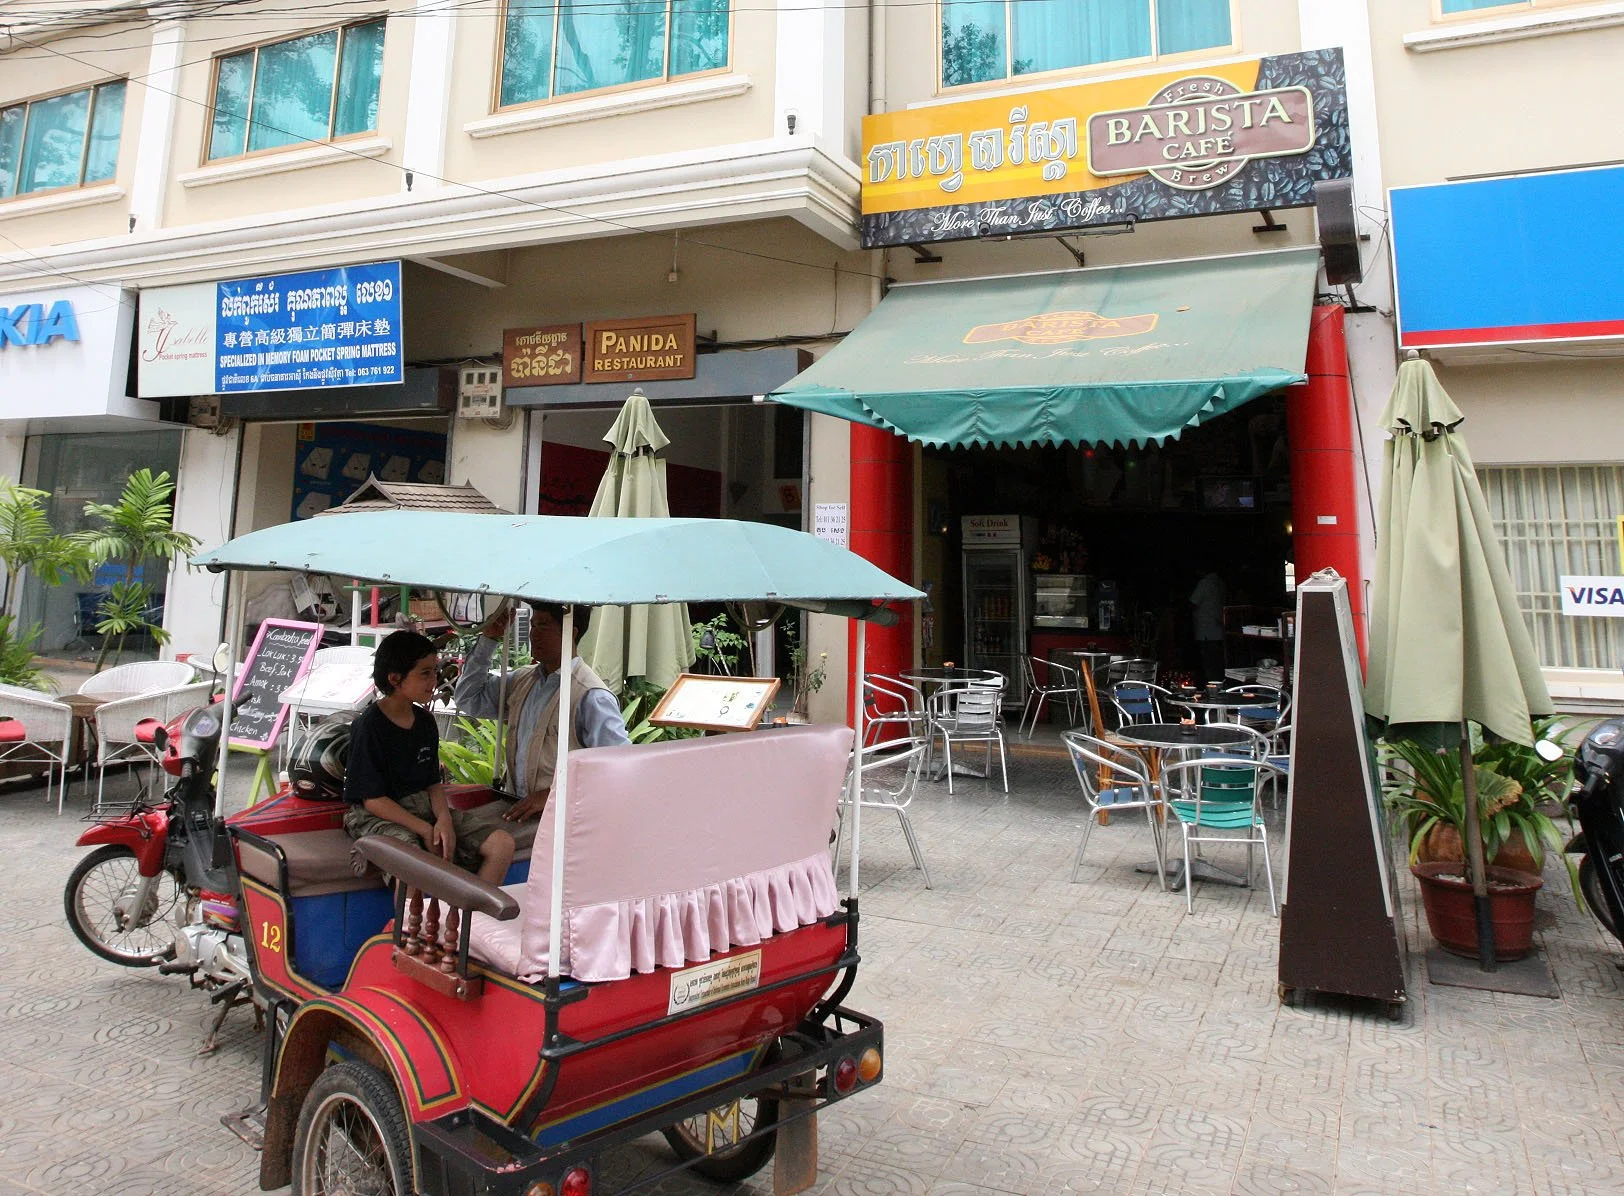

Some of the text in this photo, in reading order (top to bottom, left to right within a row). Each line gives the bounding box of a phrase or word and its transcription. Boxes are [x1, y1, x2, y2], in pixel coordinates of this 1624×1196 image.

[1163, 81, 1225, 103] Fresh
[1106, 97, 1293, 146] BARISTA
[1162, 131, 1235, 160] CAFÉ
[1171, 163, 1230, 184] Brew
[931, 212, 975, 232] More
[978, 207, 1022, 226] Than
[1019, 199, 1058, 226] Just
[601, 331, 678, 354] PANIDA
[220, 342, 396, 368] SPECIALIZED IN MEMORY FOAM POCKET SPRING MATTRESS
[594, 354, 684, 371] RESTAURANT
[345, 368, 356, 377] Tel:
[357, 367, 369, 376] 063
[370, 366, 381, 375] 761
[382, 365, 395, 374] 922
[987, 519, 1008, 527] Drink
[1565, 586, 1624, 605] VISA
[229, 721, 258, 735] Chicken
[261, 921, 281, 953] 12
